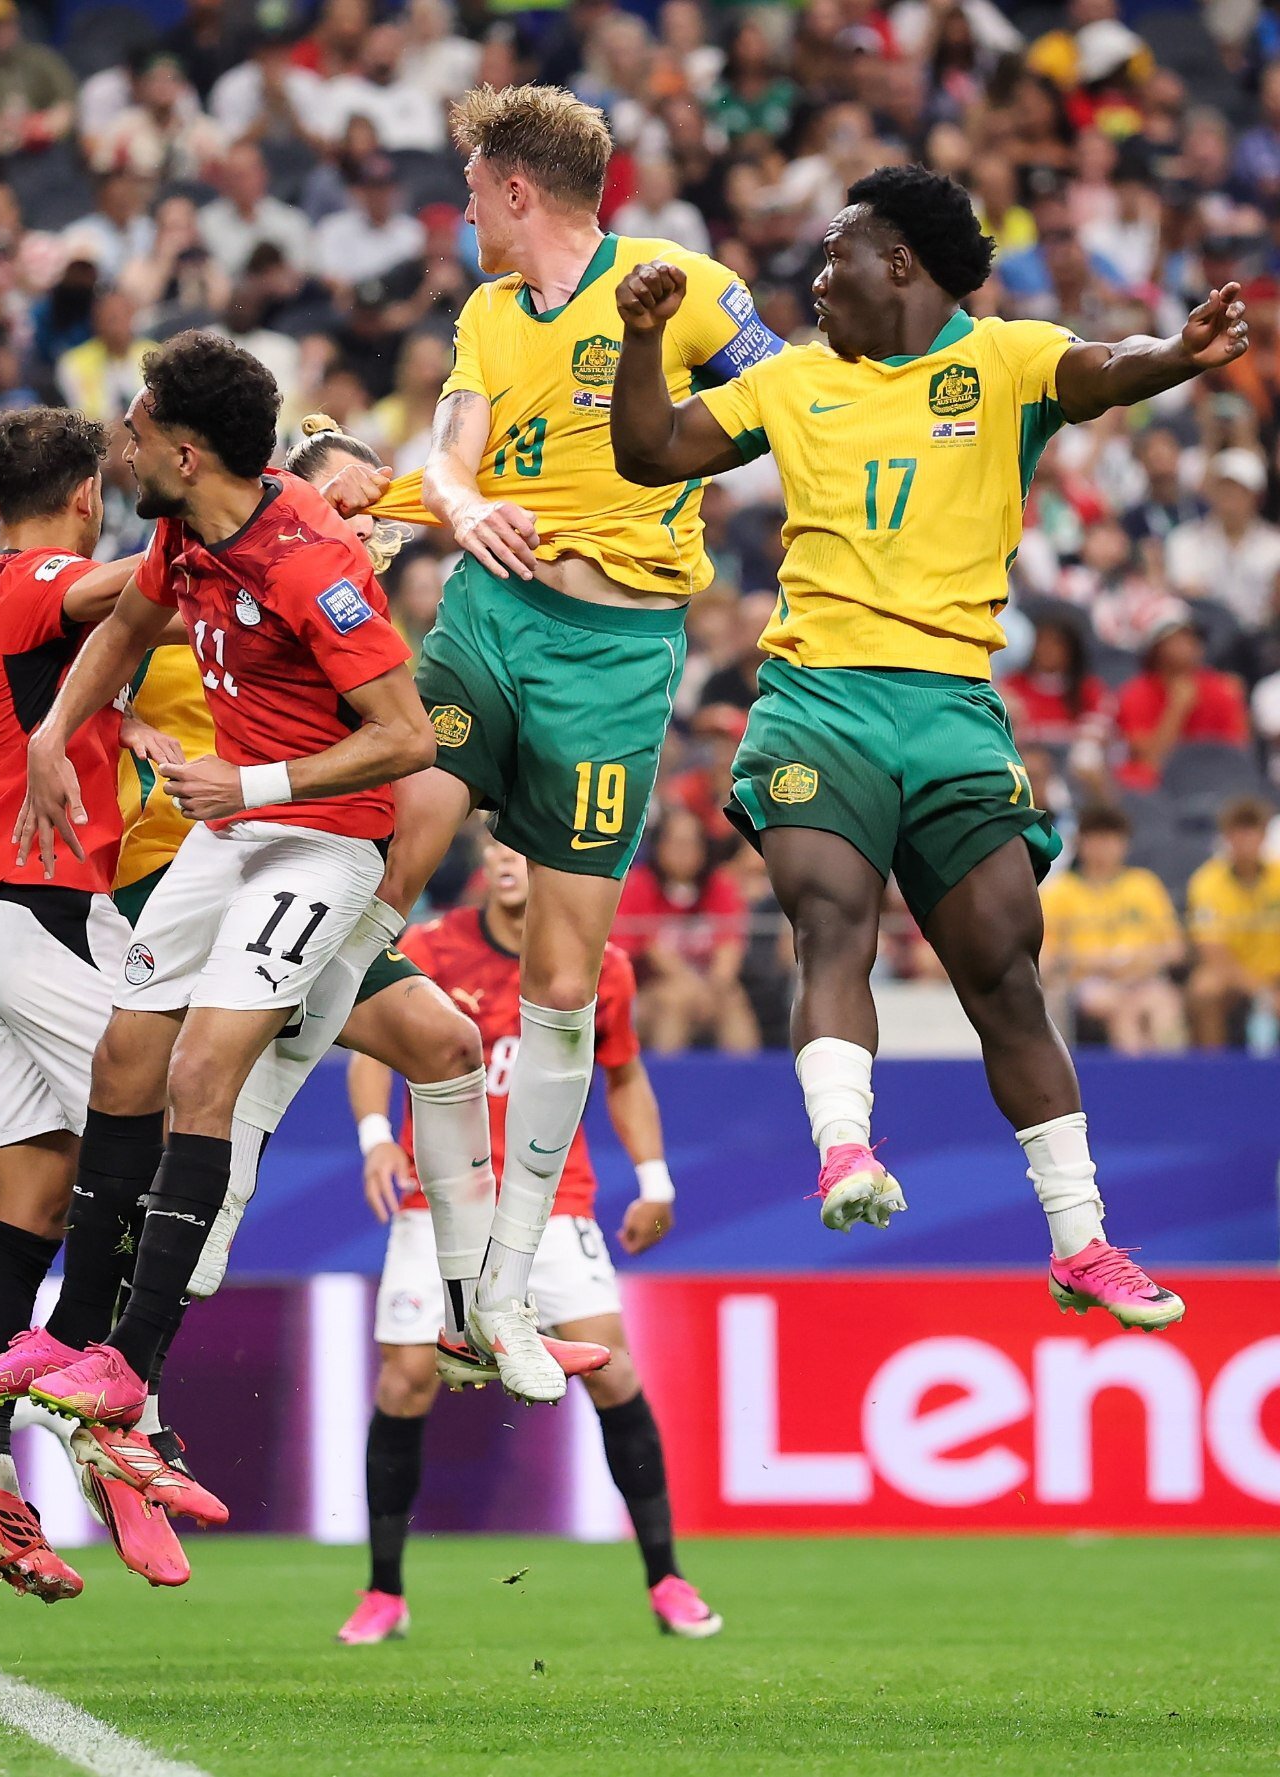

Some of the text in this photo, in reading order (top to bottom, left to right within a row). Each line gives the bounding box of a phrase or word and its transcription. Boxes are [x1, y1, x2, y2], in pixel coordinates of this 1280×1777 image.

[724, 319, 759, 356] FOOTBALL
[730, 326, 765, 365] UNITES
[750, 332, 774, 361] World
[936, 394, 973, 406] AUSTRALIA
[493, 416, 548, 477] 19
[864, 457, 917, 531] 17
[325, 585, 351, 604] FOOTBALL
[331, 592, 357, 615] UNITES
[194, 619, 238, 697] 11
[573, 761, 626, 834] 19
[245, 891, 331, 966] 11
[487, 1036, 520, 1096] 8
[718, 1292, 1280, 1507] Leno
